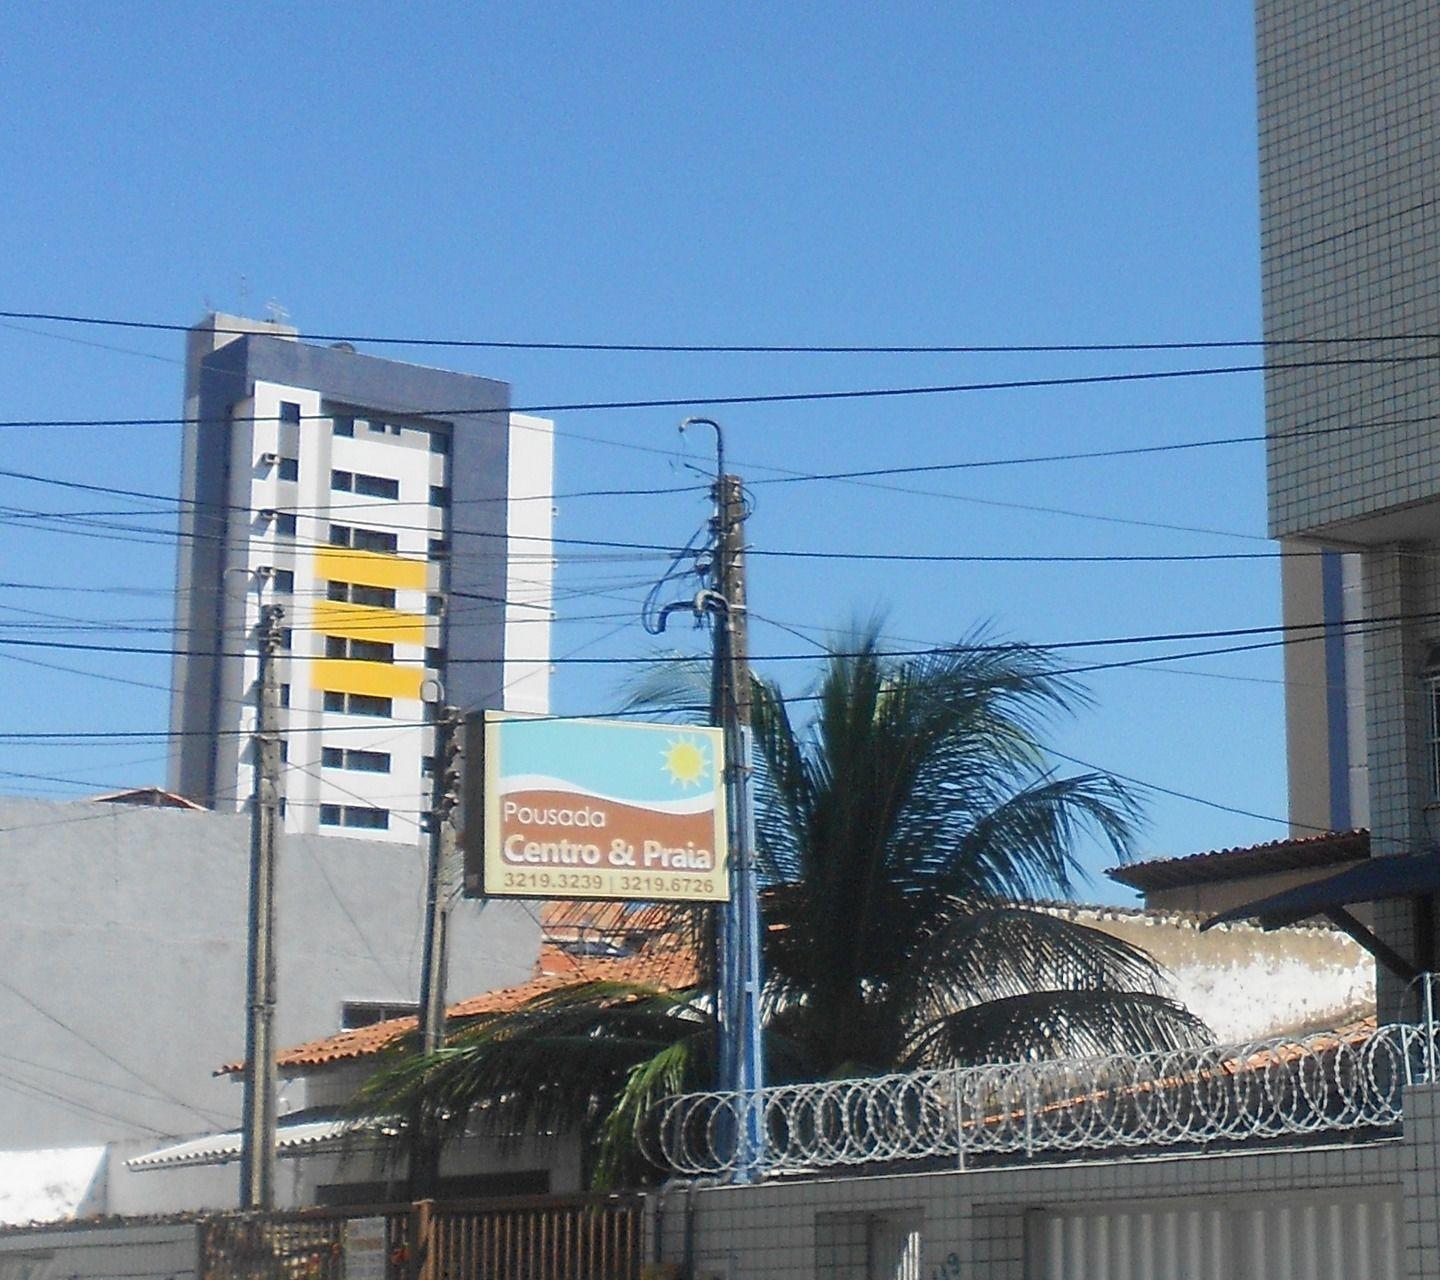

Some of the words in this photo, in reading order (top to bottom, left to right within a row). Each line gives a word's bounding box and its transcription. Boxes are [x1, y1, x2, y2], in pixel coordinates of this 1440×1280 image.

[503, 801, 606, 828] Pousada
[504, 834, 601, 865] Centro
[608, 838, 636, 866] &
[643, 840, 712, 869] Praia
[503, 872, 603, 890] 3219.3239
[620, 876, 715, 894] 3219.6726
